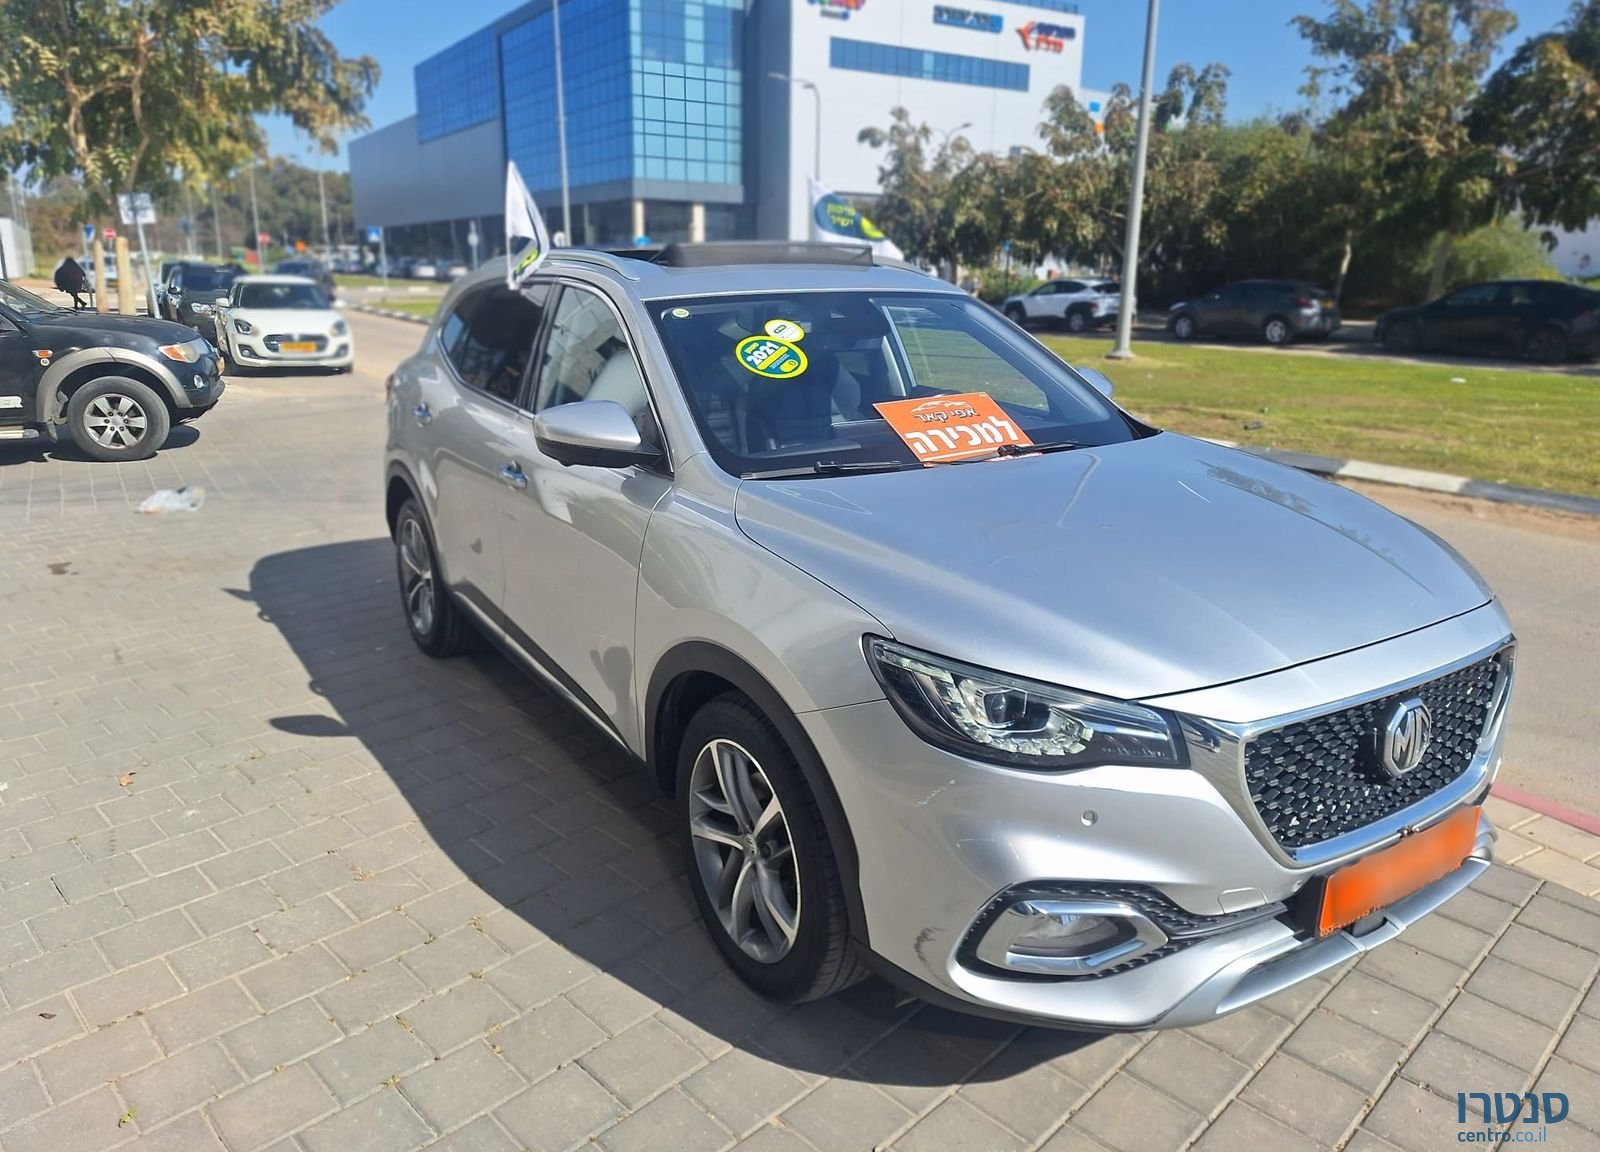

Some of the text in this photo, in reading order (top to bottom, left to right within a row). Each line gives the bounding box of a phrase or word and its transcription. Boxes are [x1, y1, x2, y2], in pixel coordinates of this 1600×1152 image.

[746, 341, 780, 366] 2021
[914, 407, 979, 423] אפי קאר
[904, 415, 1020, 455] למכירה
